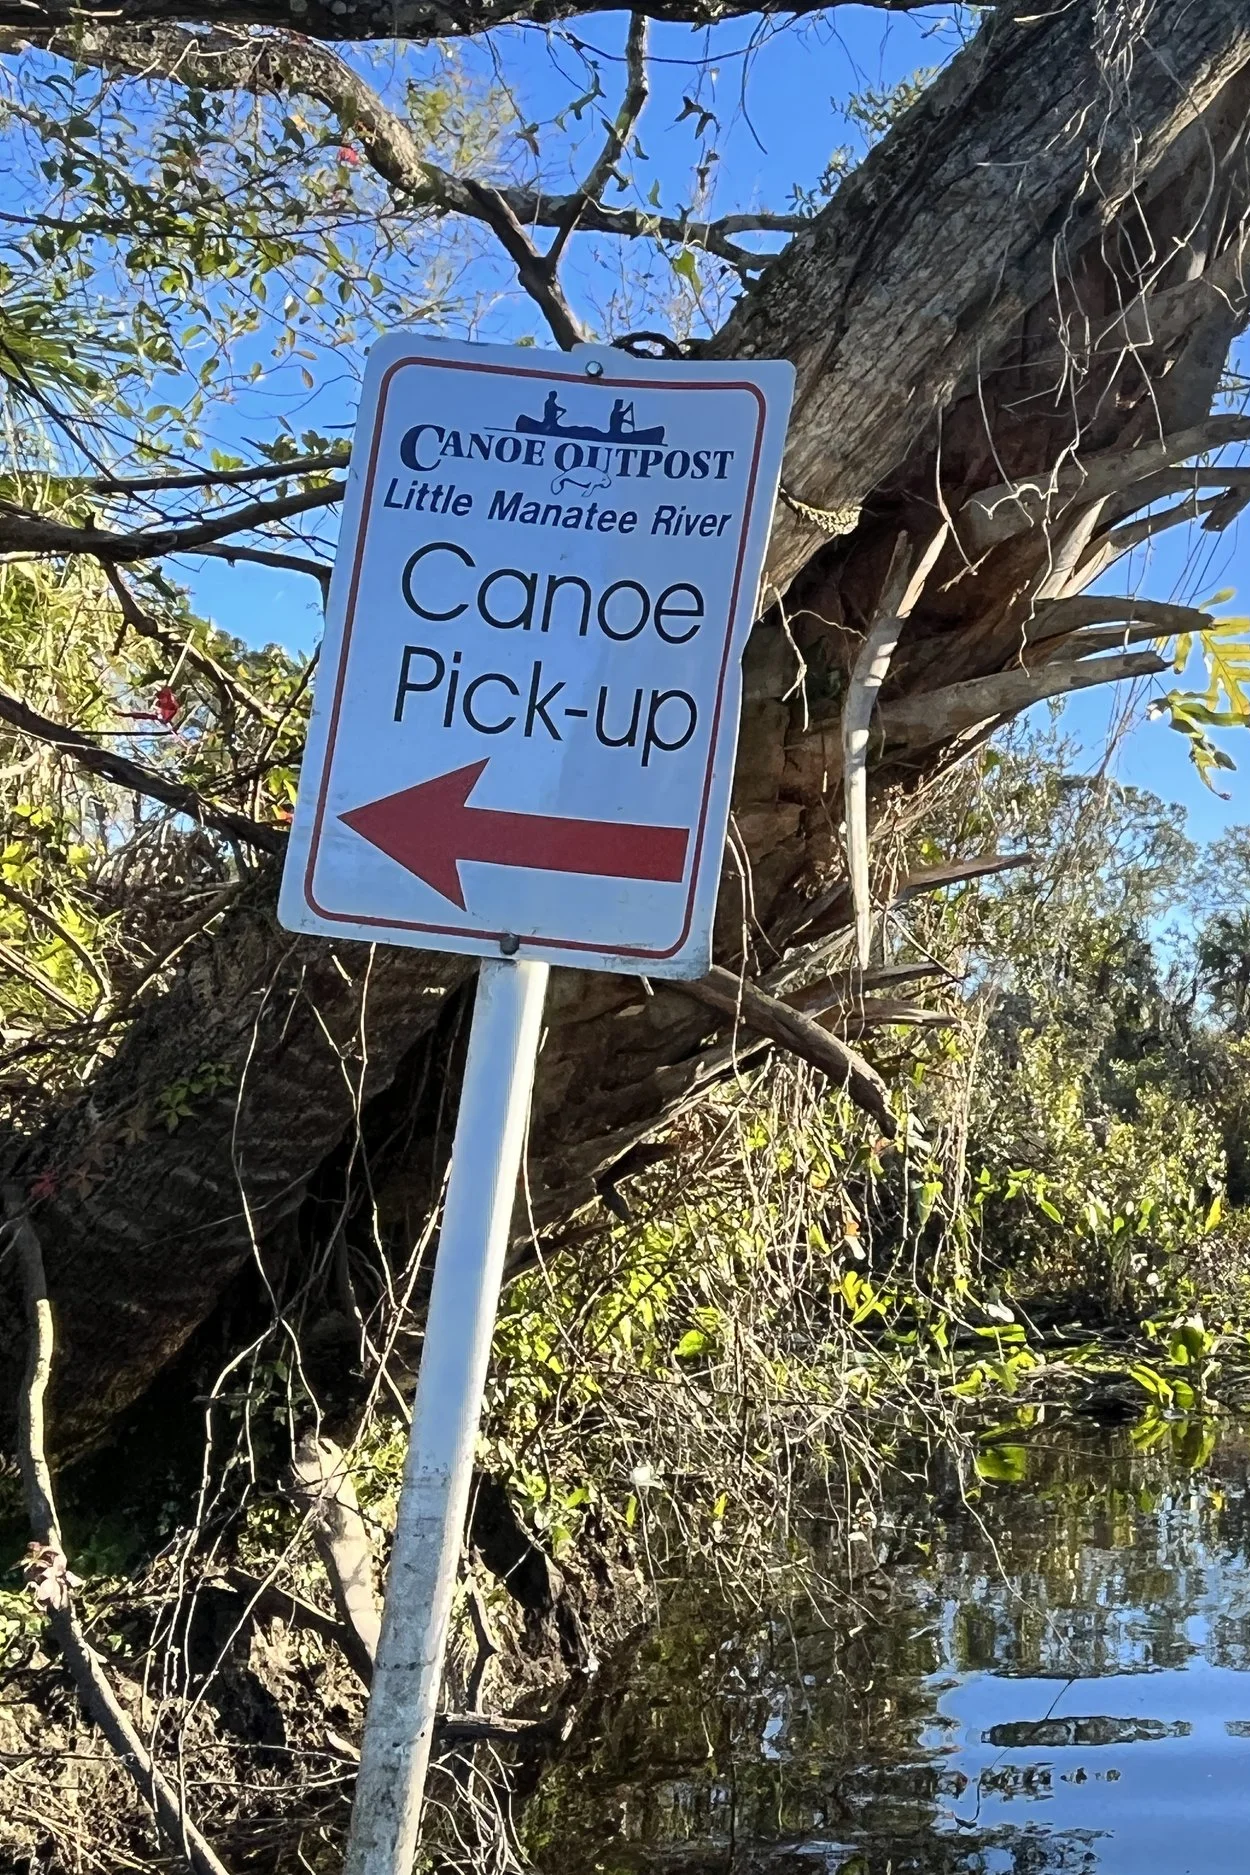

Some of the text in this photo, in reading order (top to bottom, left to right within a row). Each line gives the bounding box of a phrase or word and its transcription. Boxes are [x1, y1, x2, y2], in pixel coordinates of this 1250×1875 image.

[400, 424, 735, 480] CANOE OUTPOST
[383, 478, 733, 538] Little Manatee River
[401, 541, 705, 645] Canoe
[393, 645, 698, 768] Pick-up
